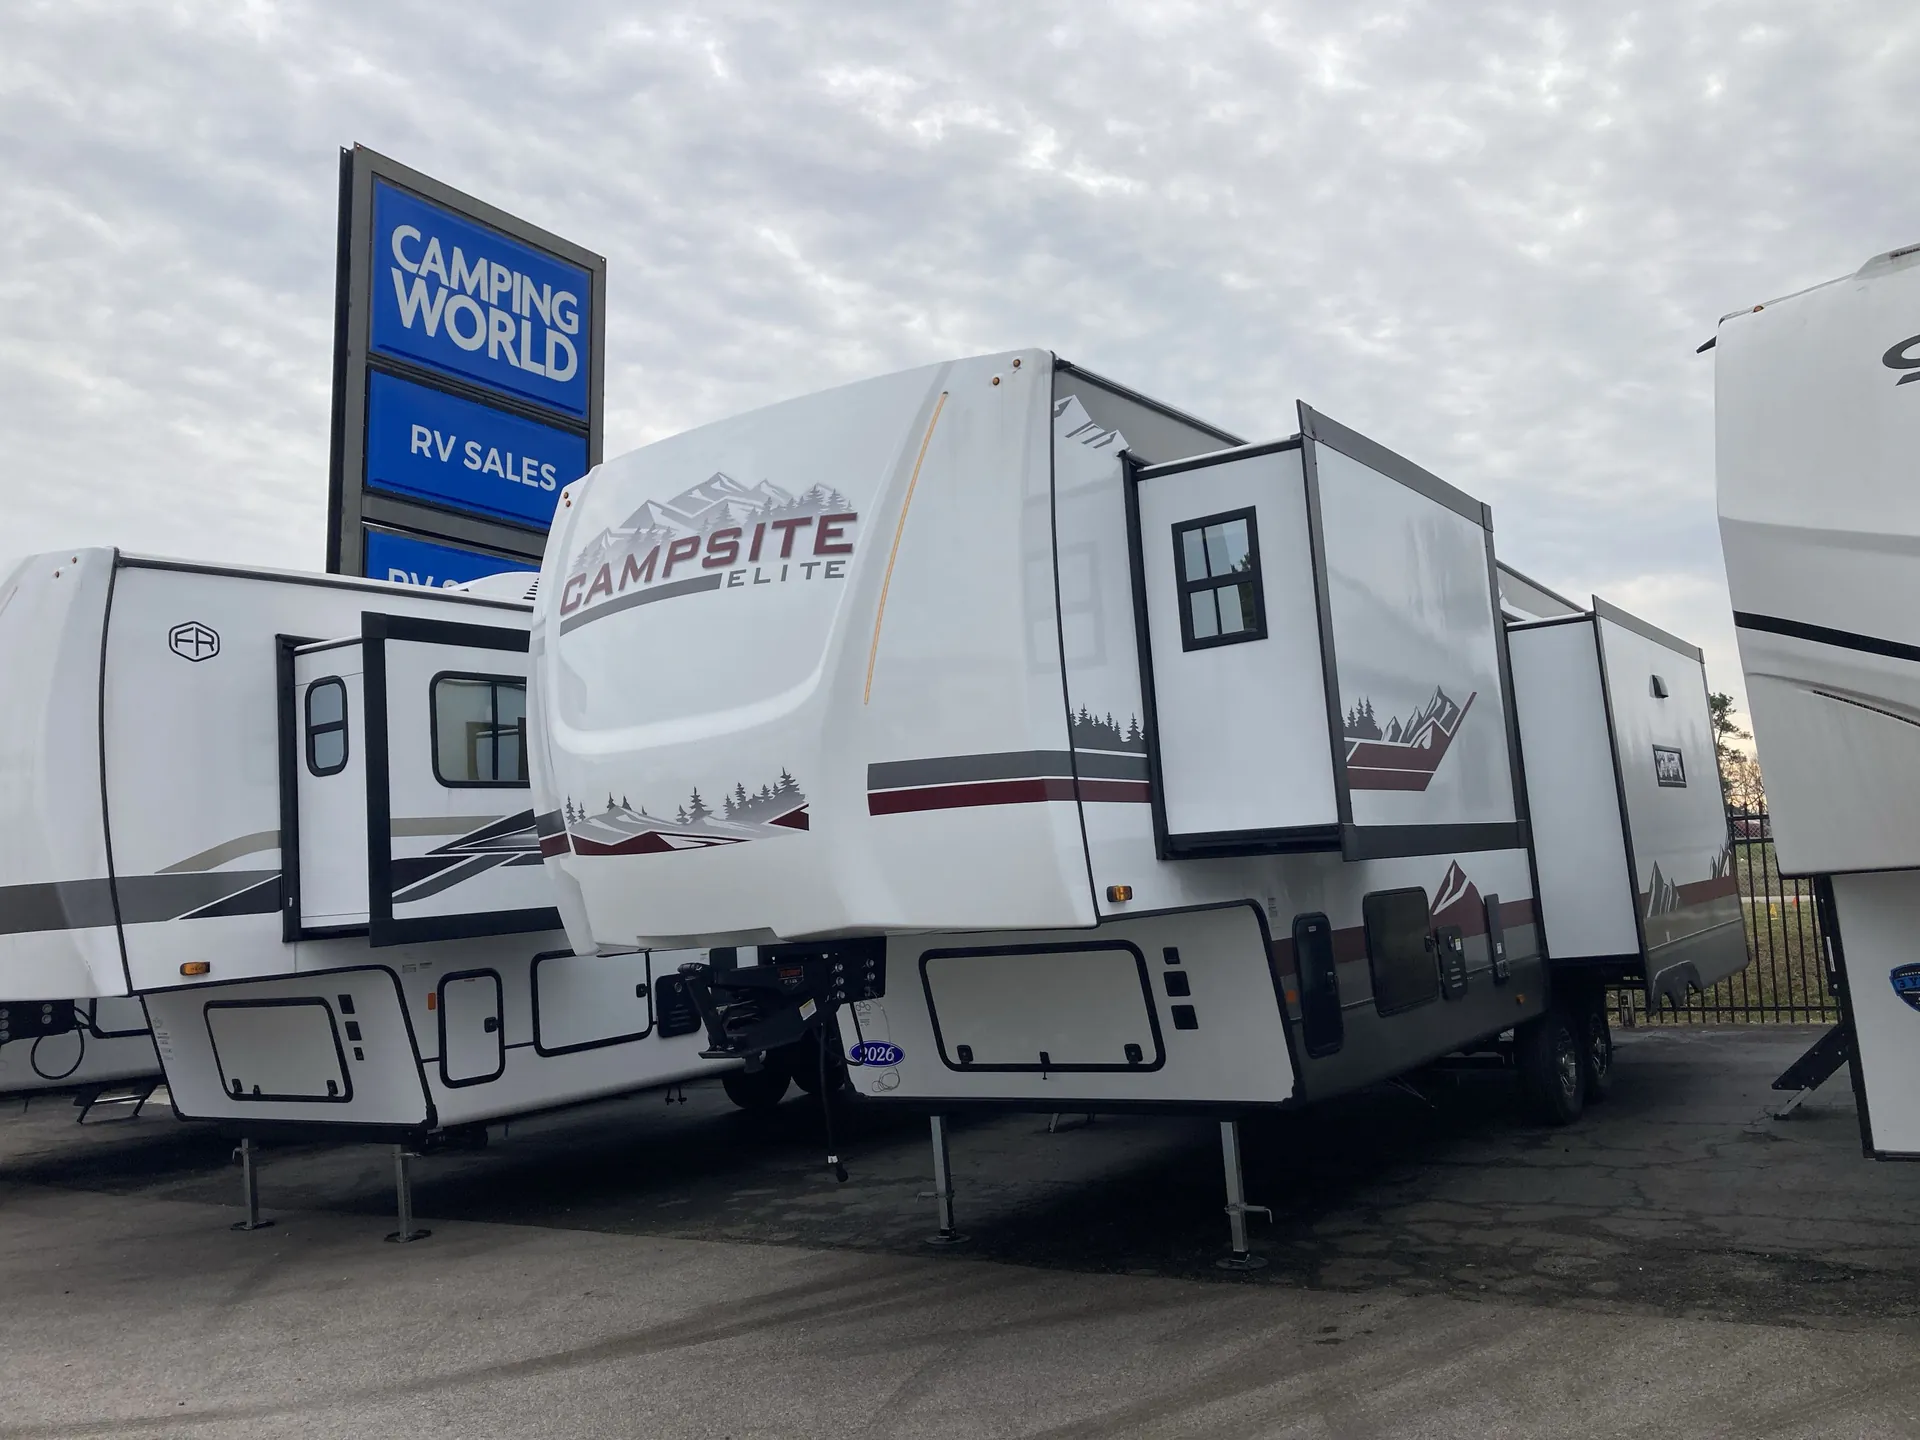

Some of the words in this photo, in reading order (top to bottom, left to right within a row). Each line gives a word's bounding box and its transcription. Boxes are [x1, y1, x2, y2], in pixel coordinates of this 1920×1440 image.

[391, 224, 579, 335] CAMPING
[391, 266, 578, 382] WORLD
[410, 424, 456, 462] RV
[463, 442, 556, 491] SALES
[560, 512, 858, 616] CAMPSITE
[726, 560, 847, 588] ELITE
